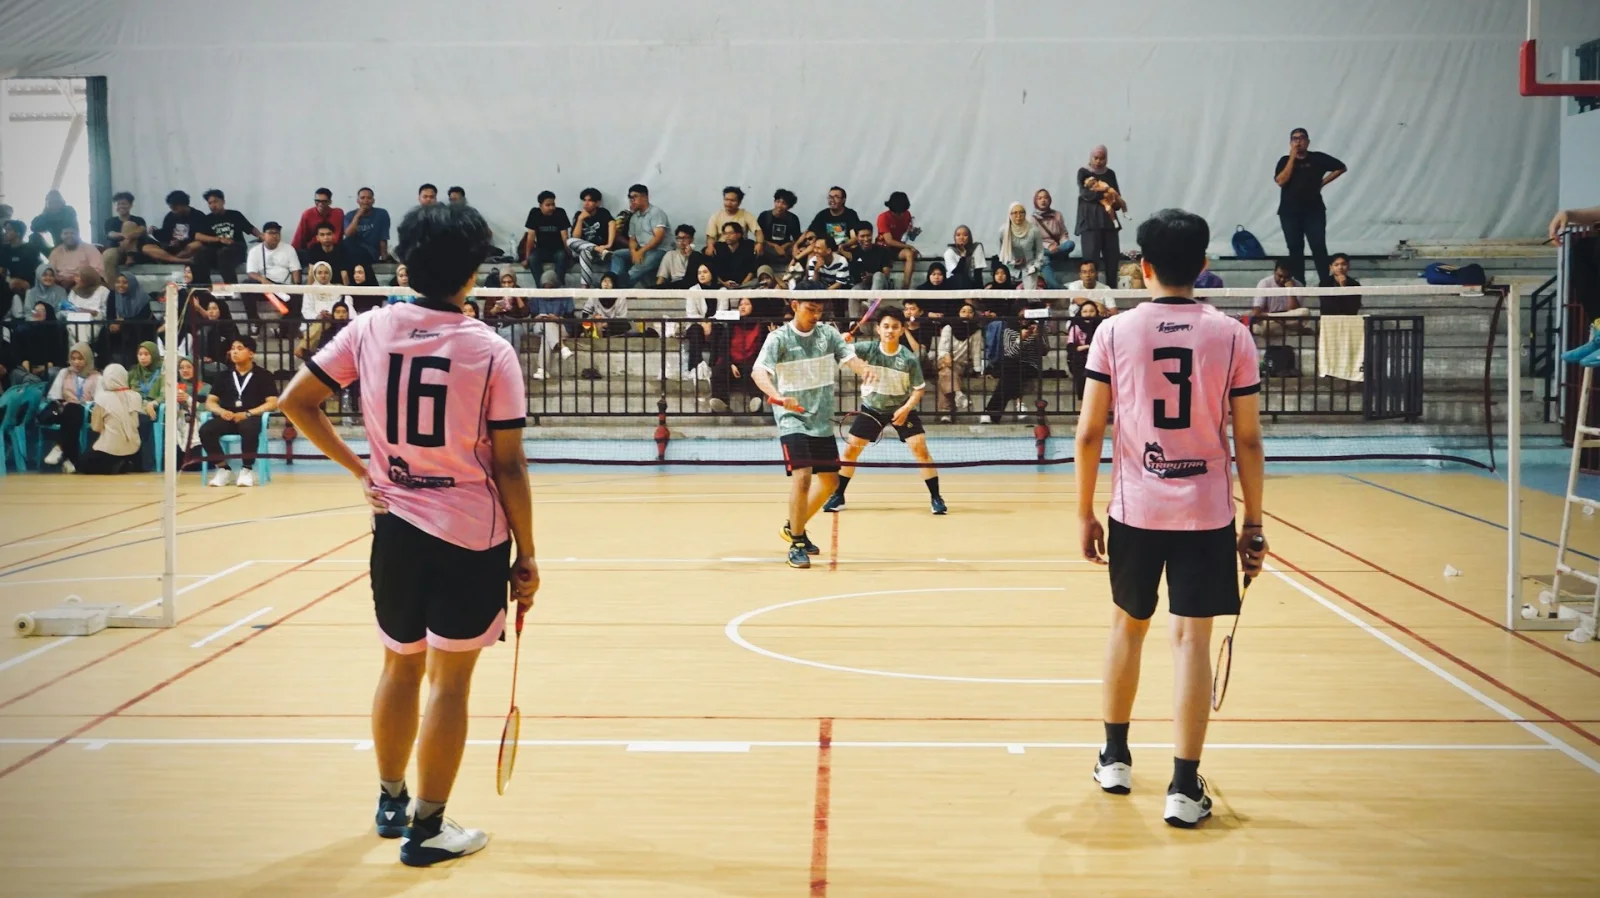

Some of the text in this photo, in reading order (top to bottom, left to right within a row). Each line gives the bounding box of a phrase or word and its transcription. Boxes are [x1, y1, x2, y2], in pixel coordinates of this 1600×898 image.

[386, 352, 451, 447] 16
[1153, 347, 1193, 430] 3
[1149, 461, 1205, 469] TRIPUTRA
